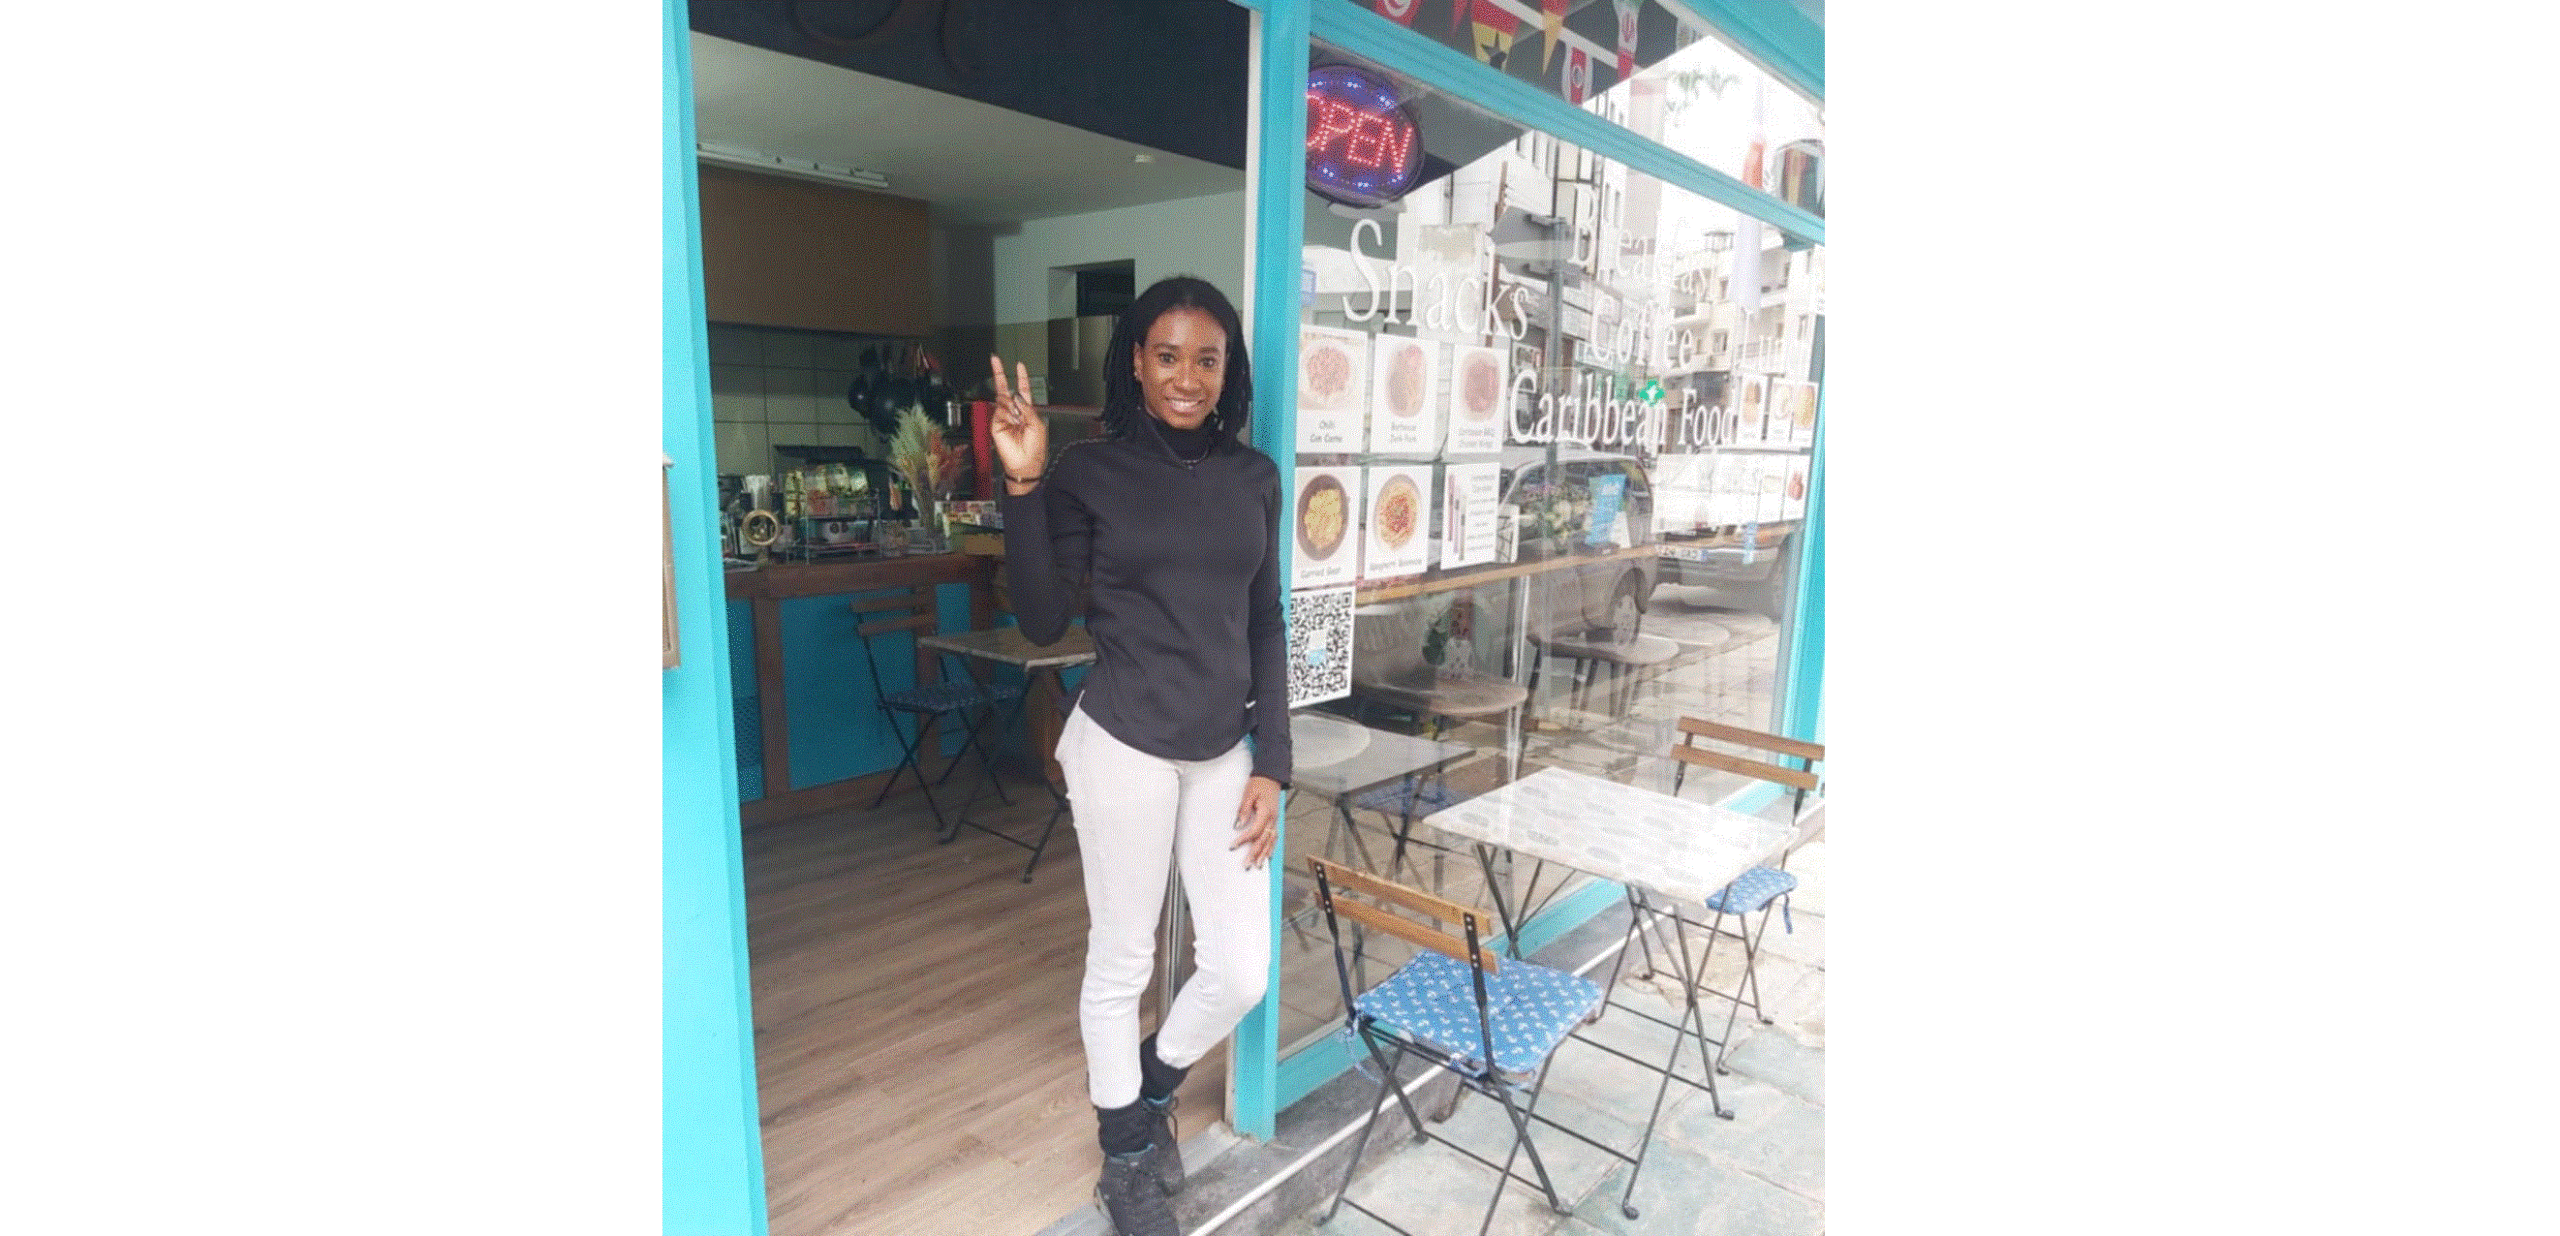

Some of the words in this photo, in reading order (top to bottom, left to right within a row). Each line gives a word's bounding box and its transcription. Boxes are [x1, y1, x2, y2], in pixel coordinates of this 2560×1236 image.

[1306, 93, 1413, 174] OPEN
[1342, 218, 1528, 340] Snacks
[1592, 294, 1695, 370] Coffee
[1509, 368, 1668, 448] Caribbean
[1677, 384, 1744, 447] Food
